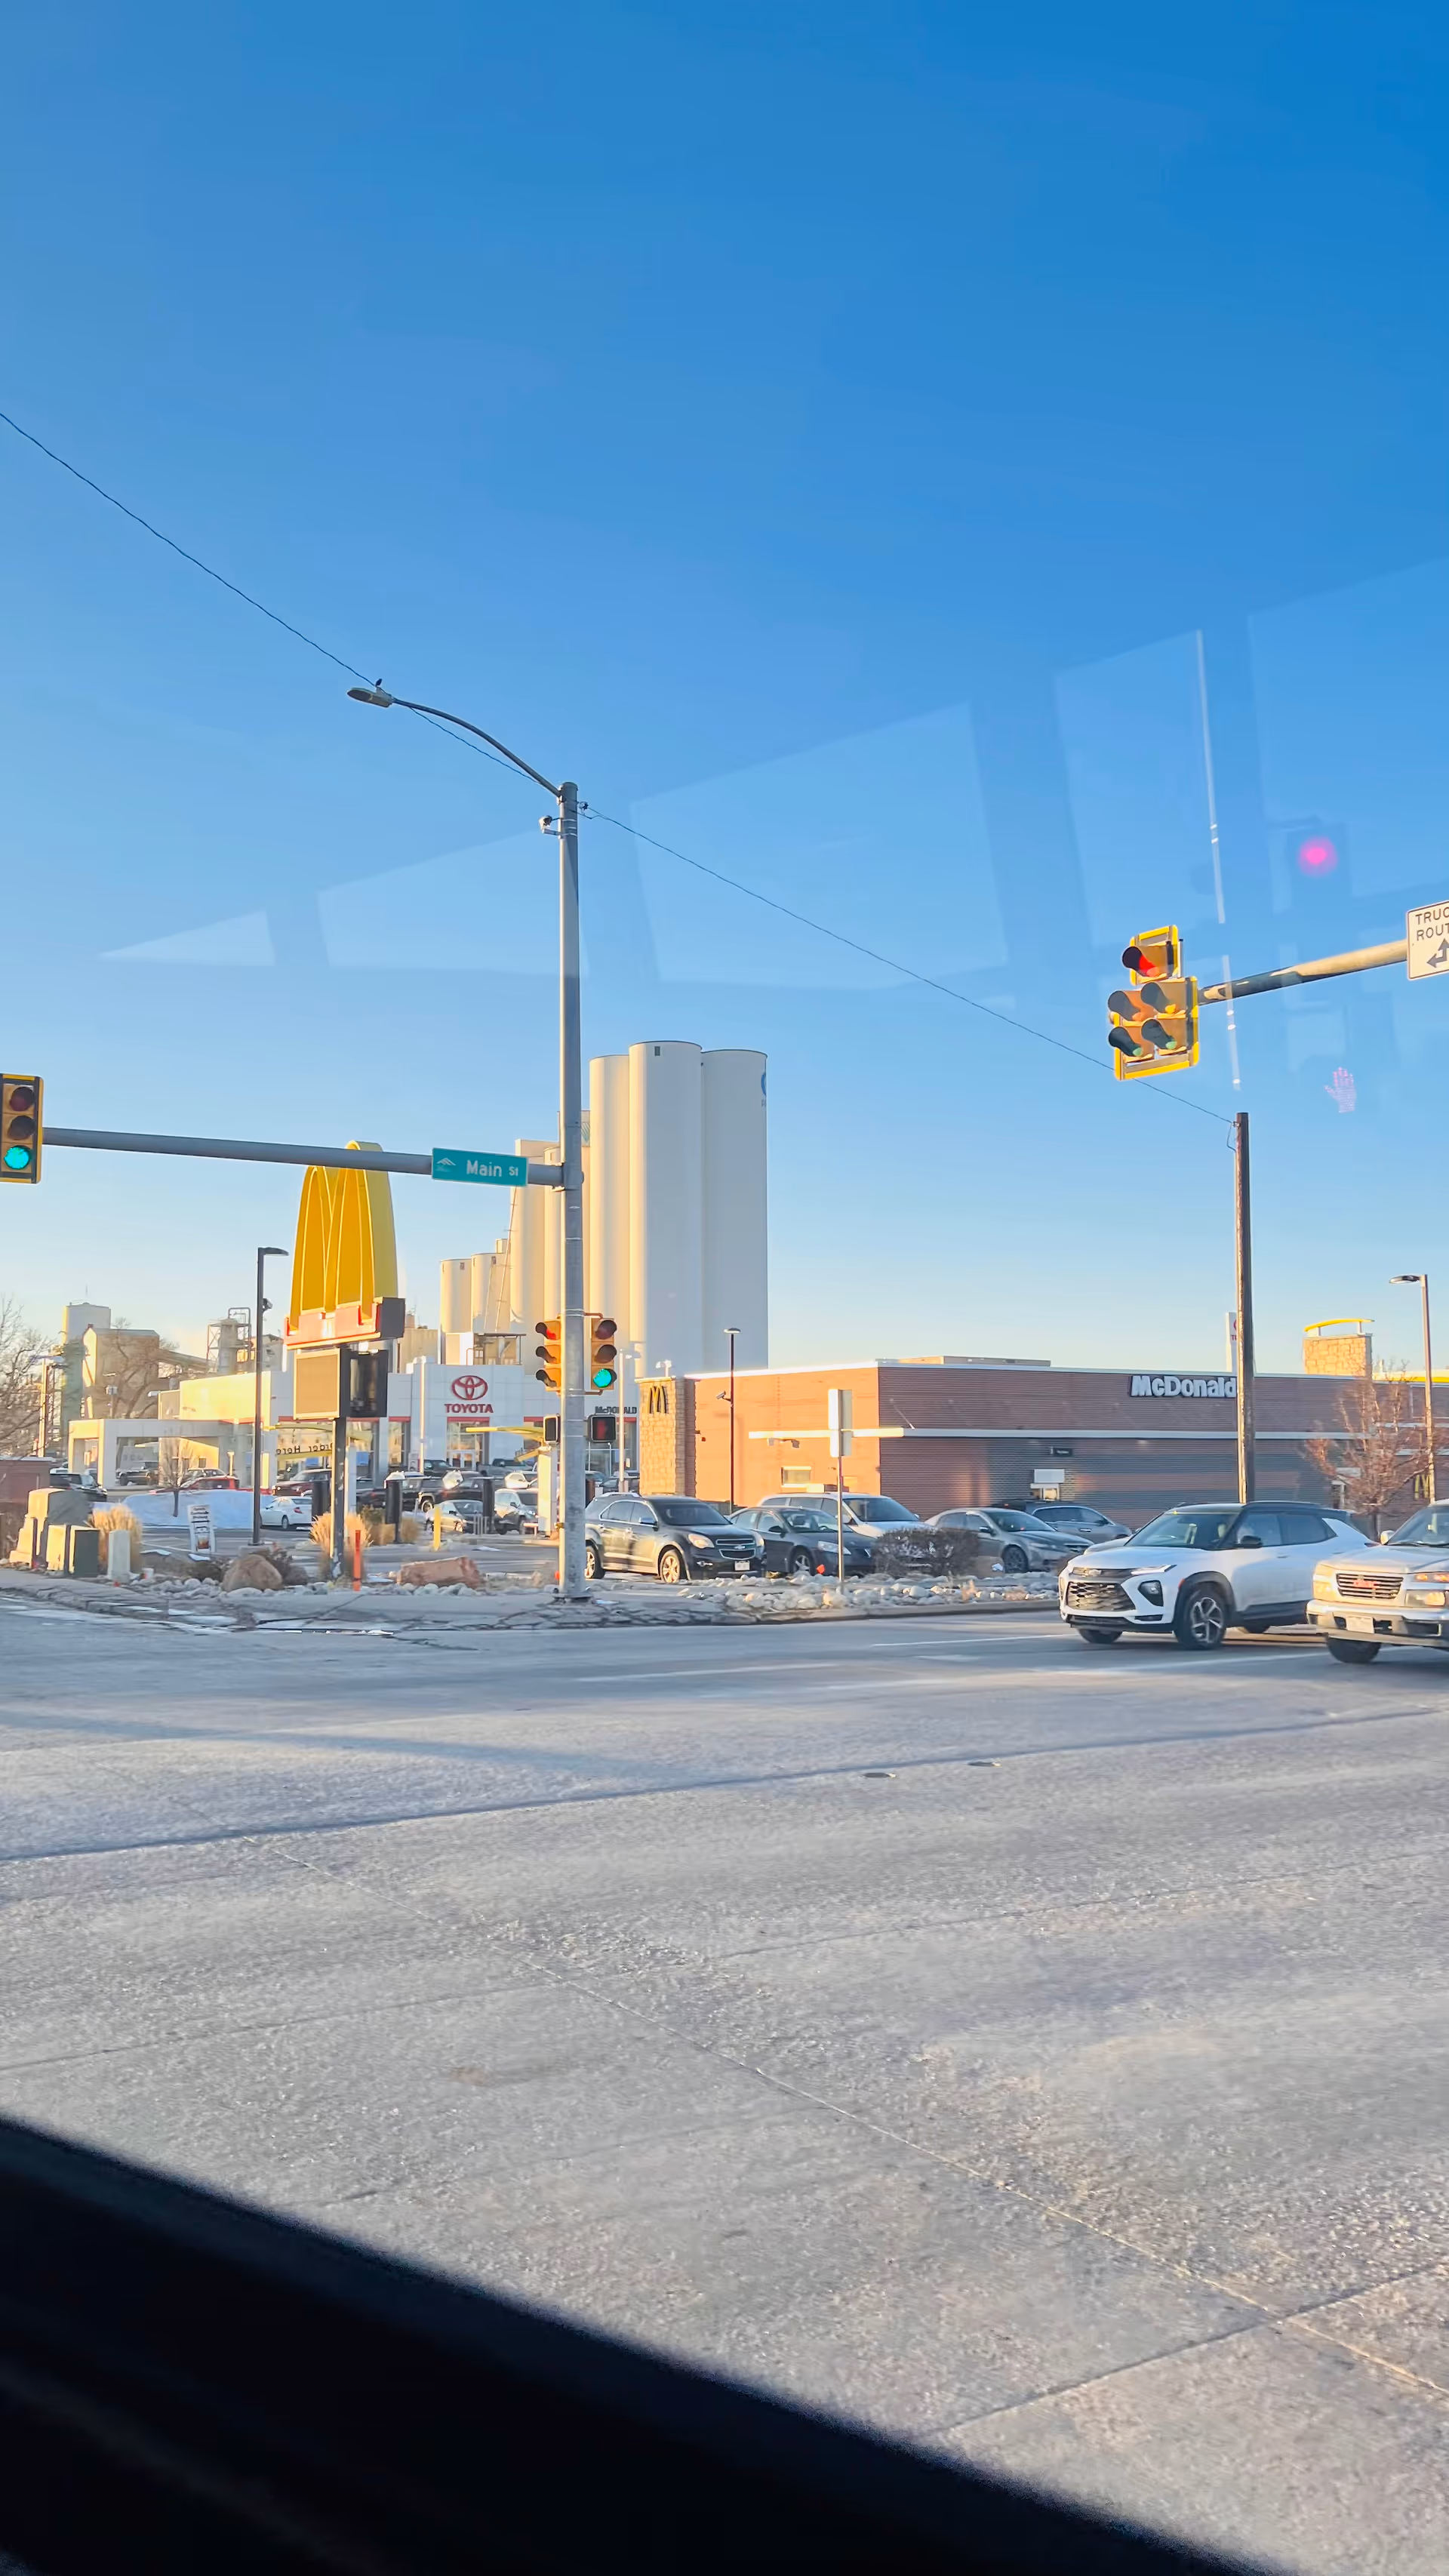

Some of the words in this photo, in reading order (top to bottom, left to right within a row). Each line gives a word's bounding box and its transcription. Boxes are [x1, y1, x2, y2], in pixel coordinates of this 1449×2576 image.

[466, 1159, 502, 1177] Main
[509, 1166, 518, 1177] St
[444, 1404, 494, 1414] TOYOTA
